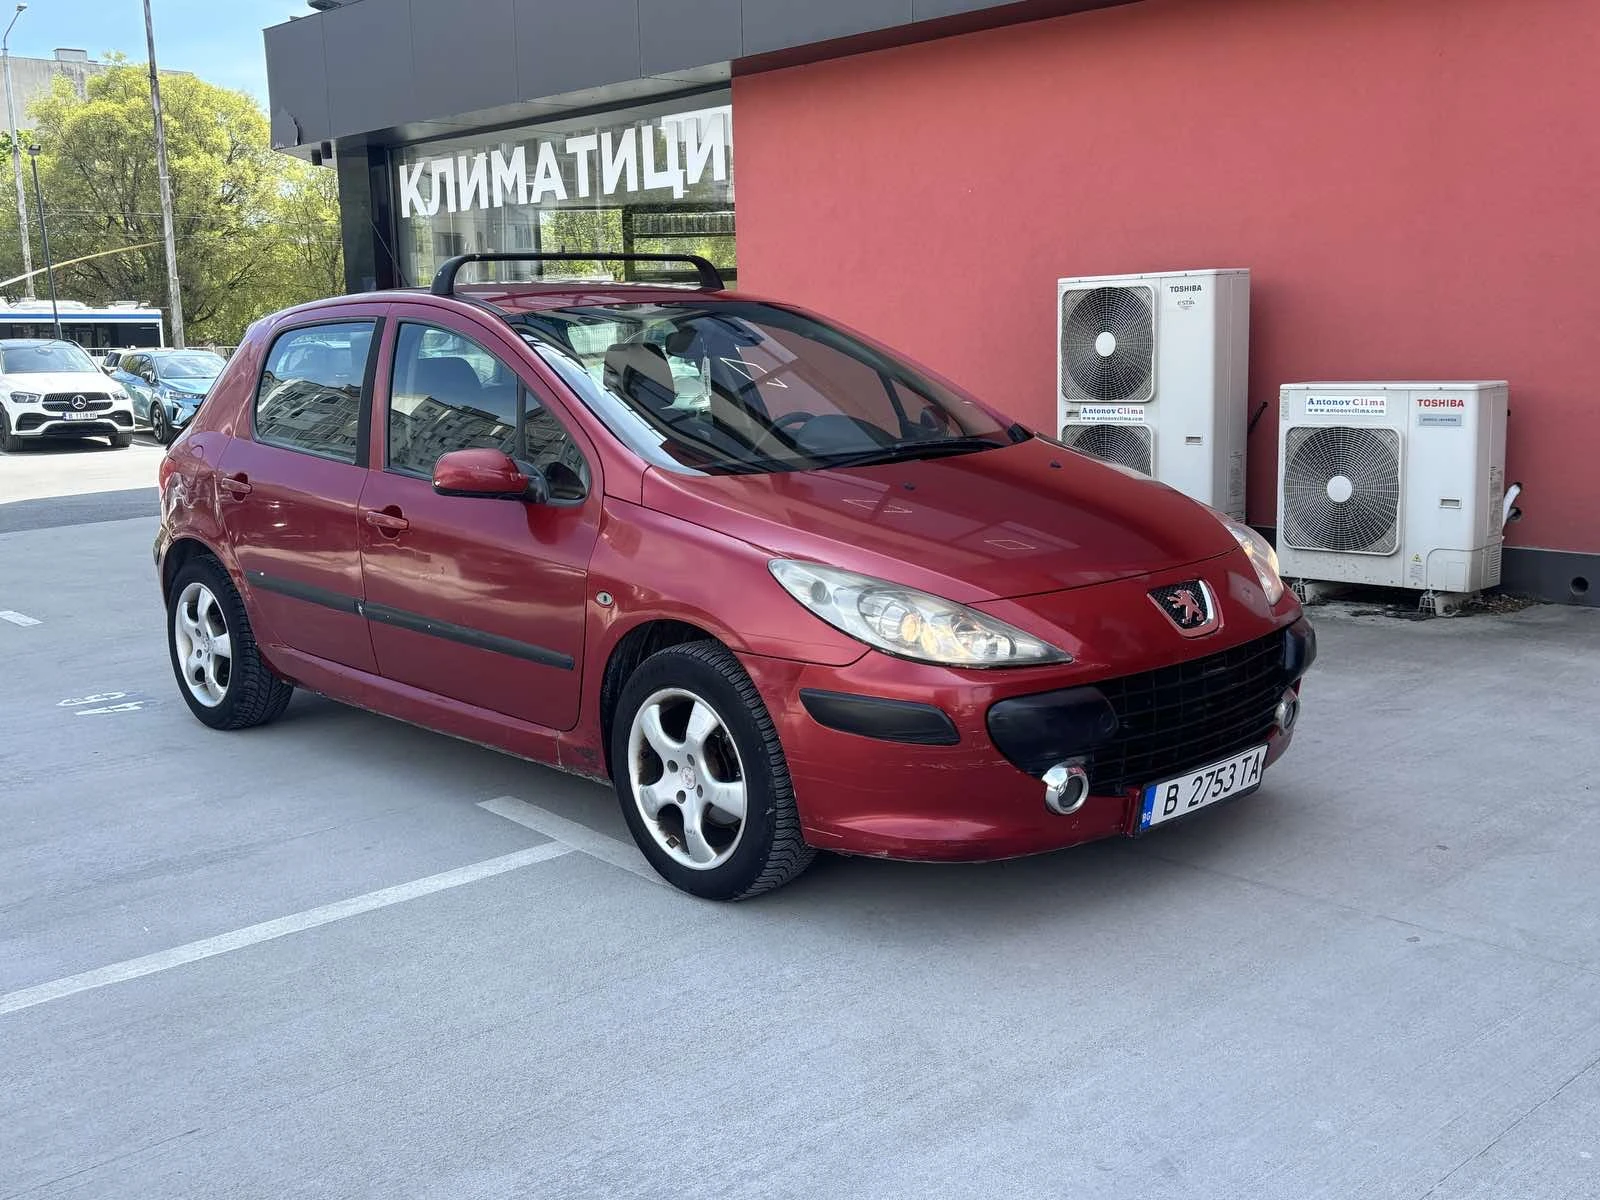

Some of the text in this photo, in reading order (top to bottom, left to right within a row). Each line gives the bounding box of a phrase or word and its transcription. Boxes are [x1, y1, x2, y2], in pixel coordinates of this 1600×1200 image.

[399, 112, 727, 218] КЛИМАТИЦИ
[1169, 285, 1202, 293] TOSHIBA
[1416, 399, 1465, 408] TOSHIBA
[1163, 752, 1260, 816] B 2753 TA
